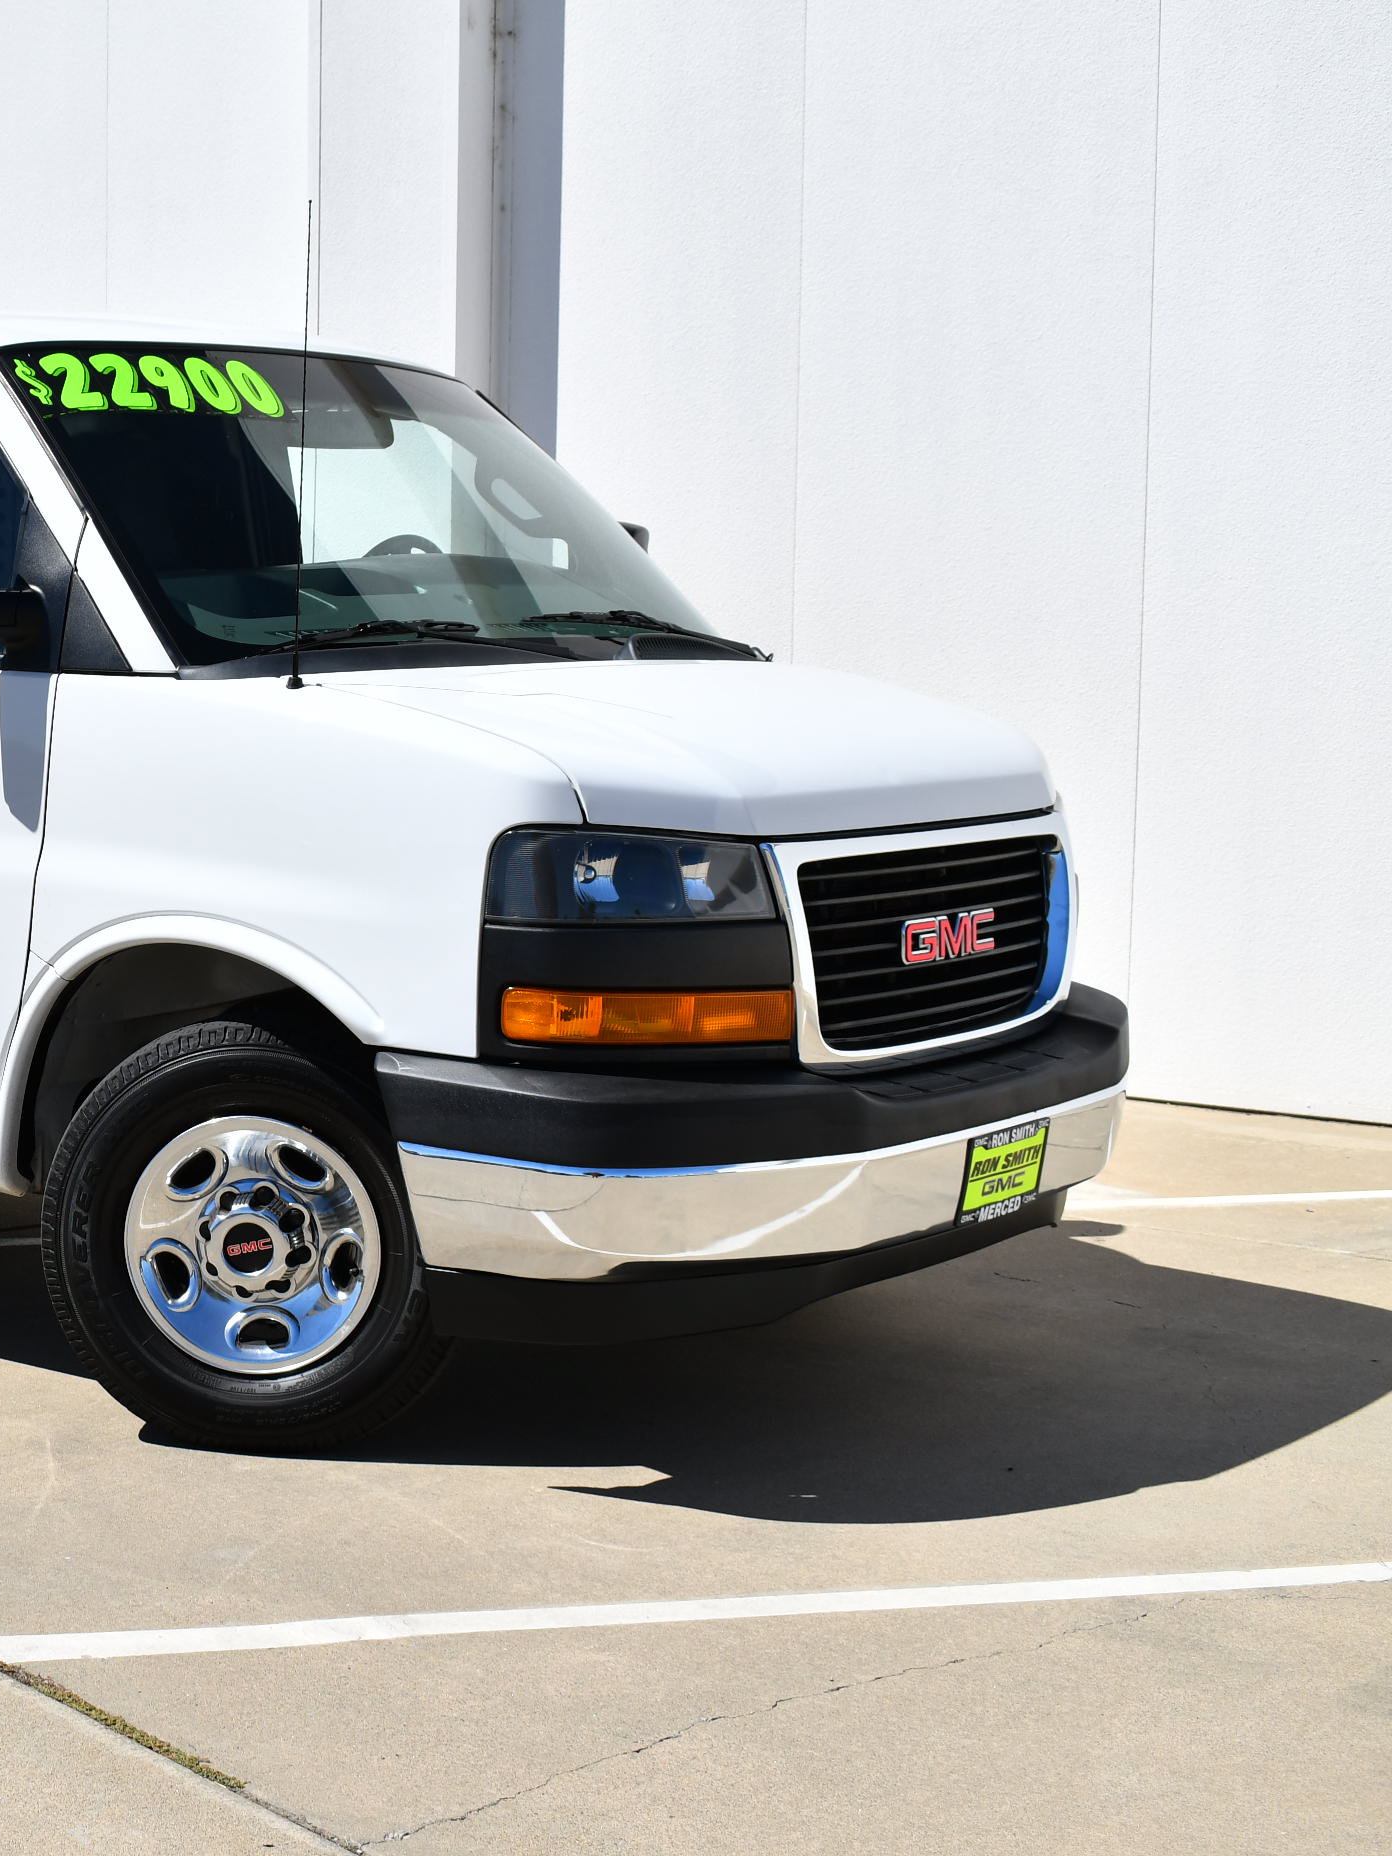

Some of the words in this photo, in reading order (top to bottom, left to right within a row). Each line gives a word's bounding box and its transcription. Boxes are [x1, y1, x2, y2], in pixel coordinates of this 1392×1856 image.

[13, 352, 285, 418] $22900
[901, 907, 995, 966] GMC
[991, 1131, 1010, 1148] RON
[1011, 1122, 1036, 1142] SMITH
[971, 1155, 1001, 1178] RON
[1002, 1144, 1042, 1169] SMITH
[981, 1170, 1026, 1196] GMC
[978, 1196, 1021, 1222] MERCED
[227, 1238, 273, 1256] GMC
